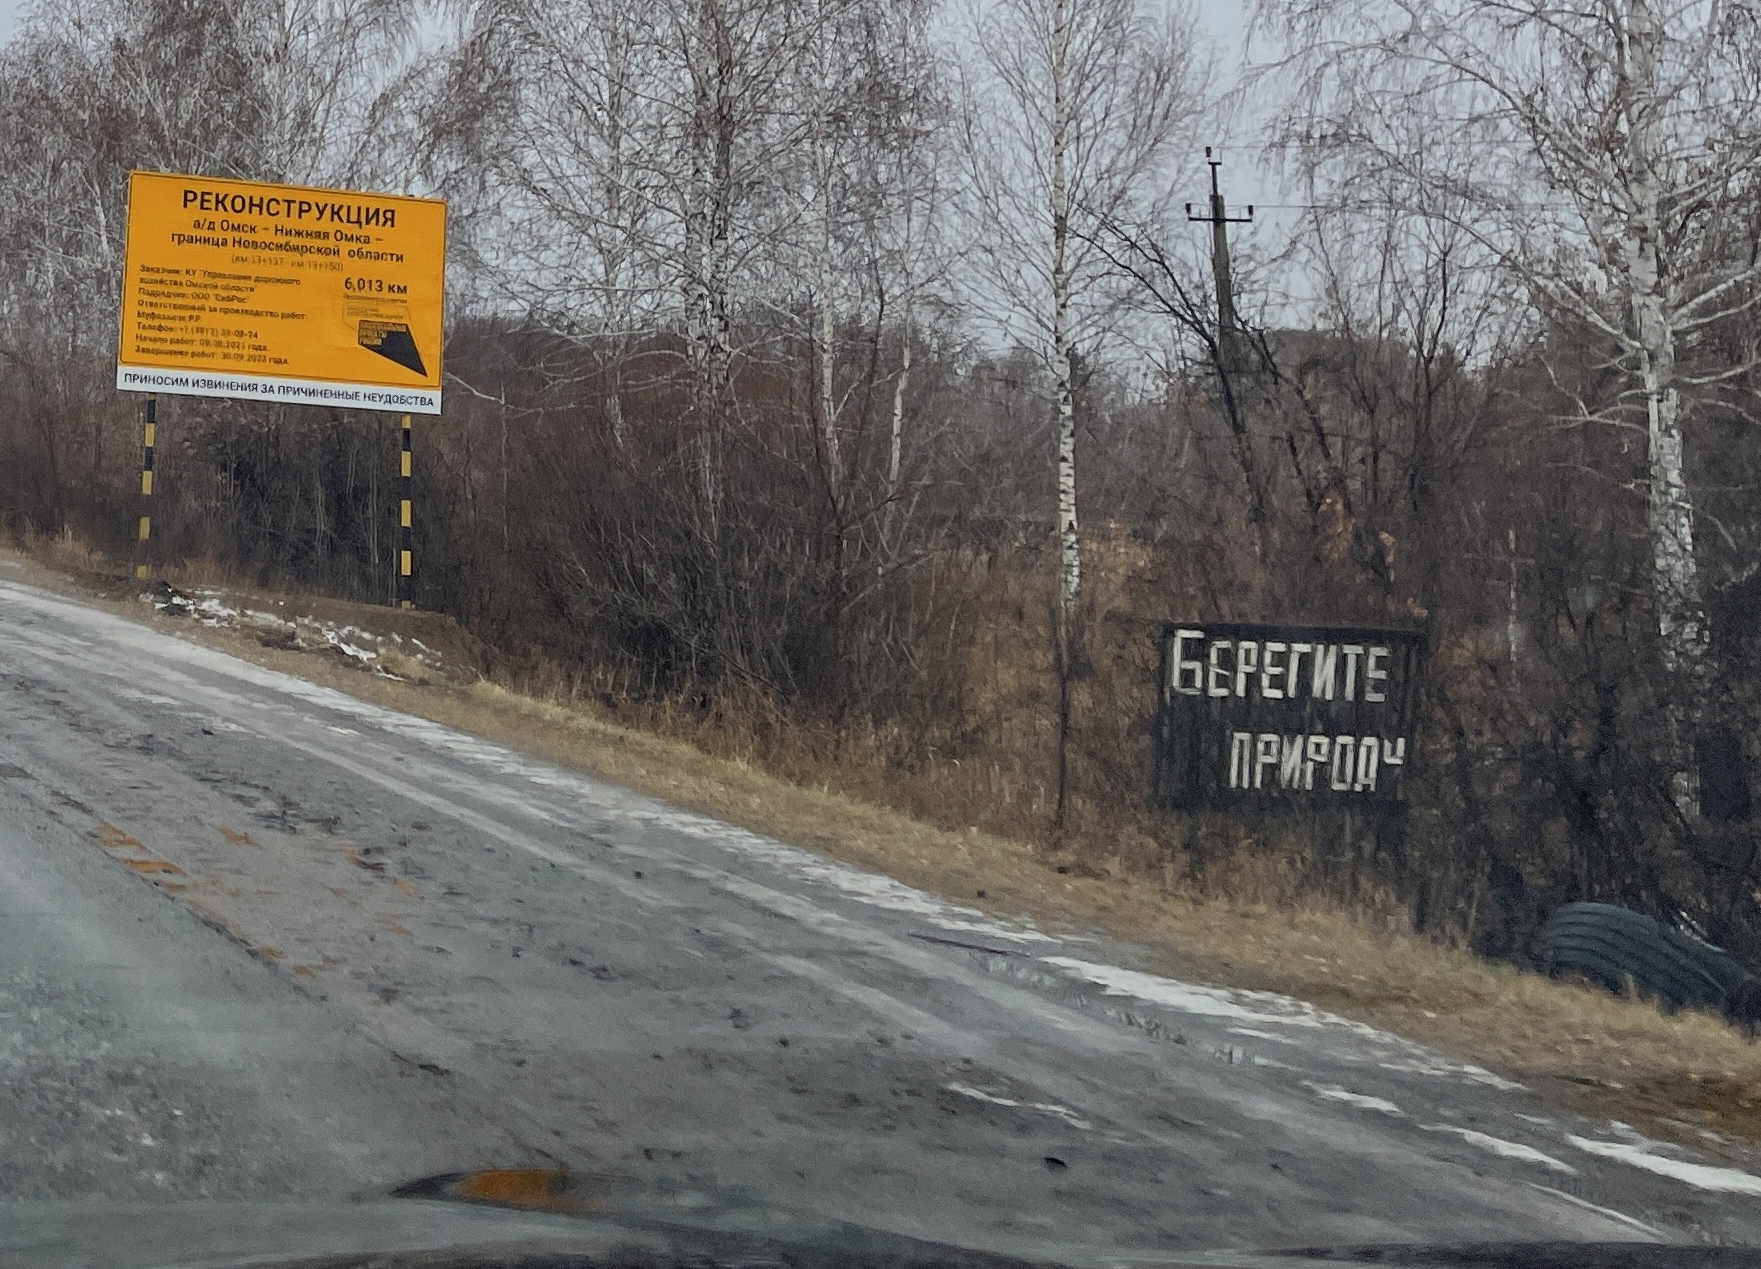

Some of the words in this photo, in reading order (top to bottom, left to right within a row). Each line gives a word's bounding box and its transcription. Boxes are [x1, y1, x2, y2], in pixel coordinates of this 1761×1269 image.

[183, 190, 396, 229] РЕКОНСТРУКЦИЯ
[193, 219, 215, 232] а/д
[221, 220, 257, 233] Омск
[274, 225, 330, 240] Нижняя
[334, 230, 370, 244] Омка
[171, 233, 228, 248] граница
[233, 237, 340, 257] Новосибирской
[348, 249, 404, 263] области
[344, 277, 383, 292] 6,013
[388, 284, 407, 294] км
[124, 373, 189, 388] ПРИНОСИМ
[192, 379, 258, 393] ИЗВИНЕНИЯ
[261, 384, 275, 395] ЗА
[278, 385, 360, 401] ПРИЧИНЕННЫЕ
[363, 392, 434, 407] НЕУДОБСТВА
[1171, 628, 1392, 703] БЕРЕГИТЕ
